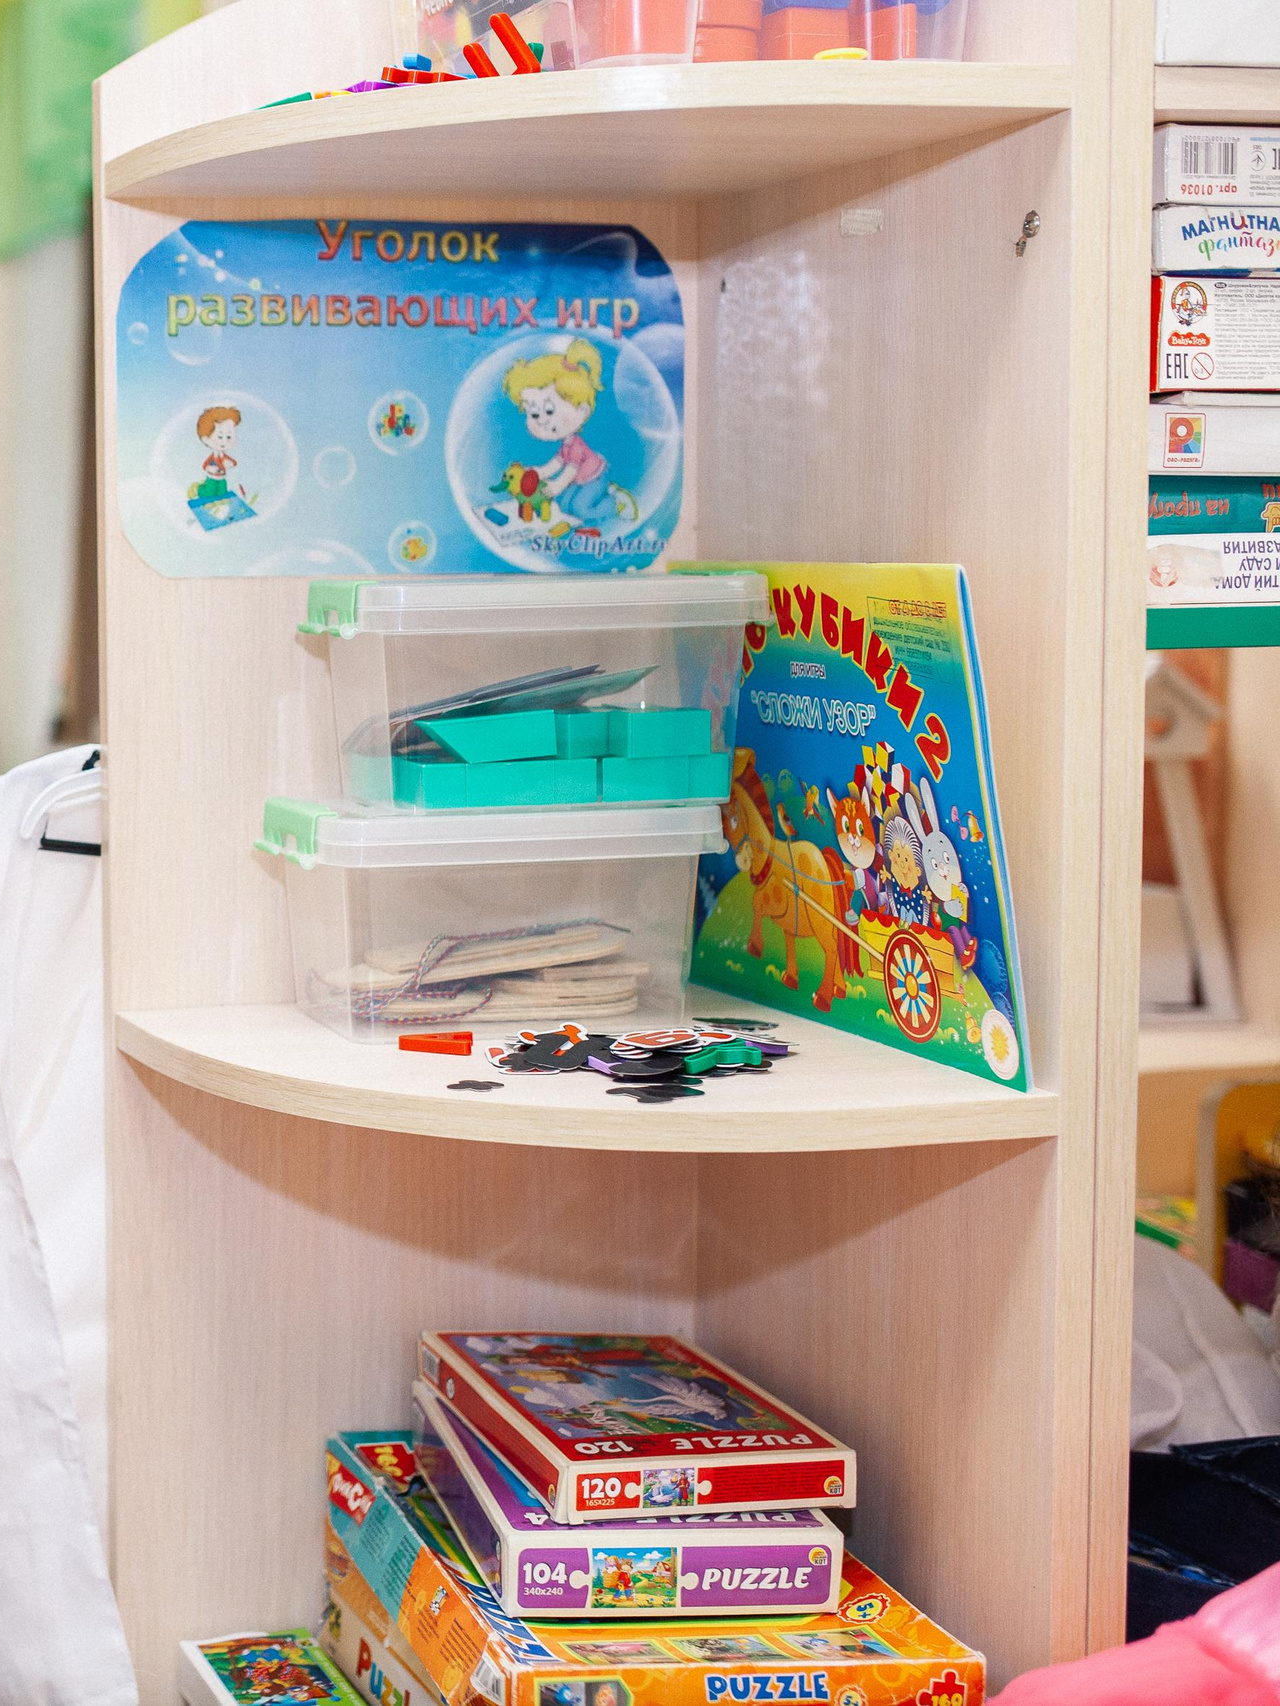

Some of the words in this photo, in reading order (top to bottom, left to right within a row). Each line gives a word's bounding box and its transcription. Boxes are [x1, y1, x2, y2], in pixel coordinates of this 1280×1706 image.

[1180, 183, 1213, 195] 01036
[1216, 183, 1238, 193] арт.
[317, 219, 500, 262] Уголок
[167, 293, 539, 336] развивающих
[557, 295, 640, 338] игр
[1172, 336, 1190, 346] Baby
[1191, 336, 1207, 346] Toys
[1166, 353, 1189, 379] EAC
[1206, 498, 1230, 516] на
[1239, 556, 1272, 571] САДУ
[771, 582, 926, 734] КУБИКИ
[915, 712, 951, 784] 2
[574, 1438, 634, 1455] 120
[670, 1433, 814, 1450] PUZZLE
[580, 1477, 622, 1500] 120
[523, 1562, 568, 1585] 104
[701, 1566, 813, 1591] PUZZLE
[523, 1586, 563, 1597] 340x240
[855, 1602, 875, 1620] 5+
[704, 1671, 830, 1702] PUZZLE
